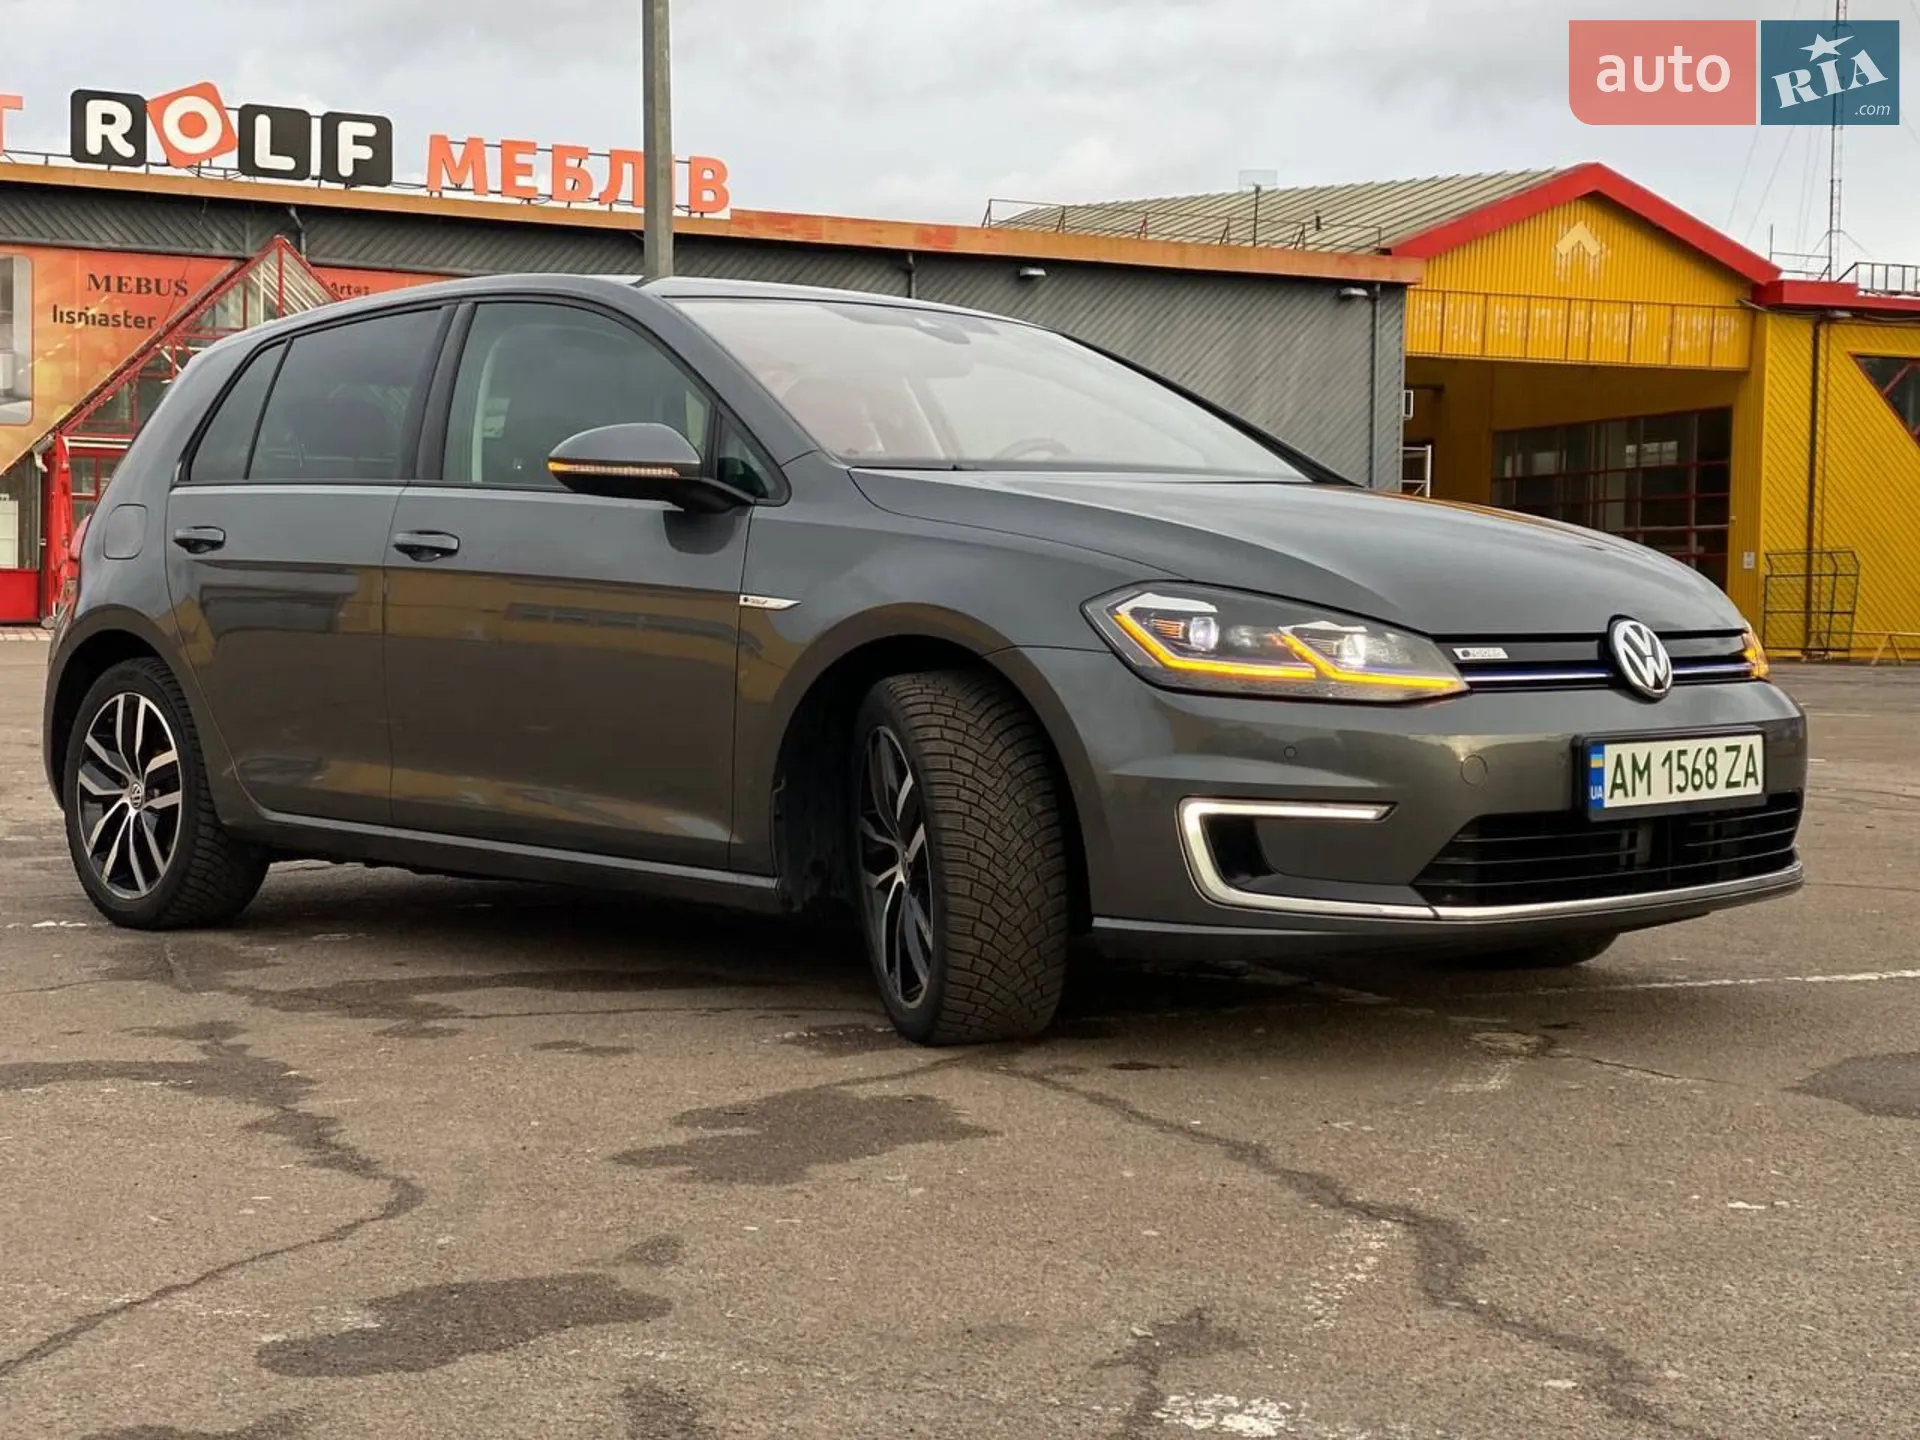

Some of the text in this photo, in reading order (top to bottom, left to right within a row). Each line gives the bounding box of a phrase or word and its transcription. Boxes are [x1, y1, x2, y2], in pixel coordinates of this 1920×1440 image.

[85, 94, 378, 178] ROLF
[426, 134, 730, 213] МЕБЛВ
[87, 273, 189, 297] MEBUS
[1590, 785, 1604, 801] UA
[1609, 743, 1760, 800] AM 1568 ZA
